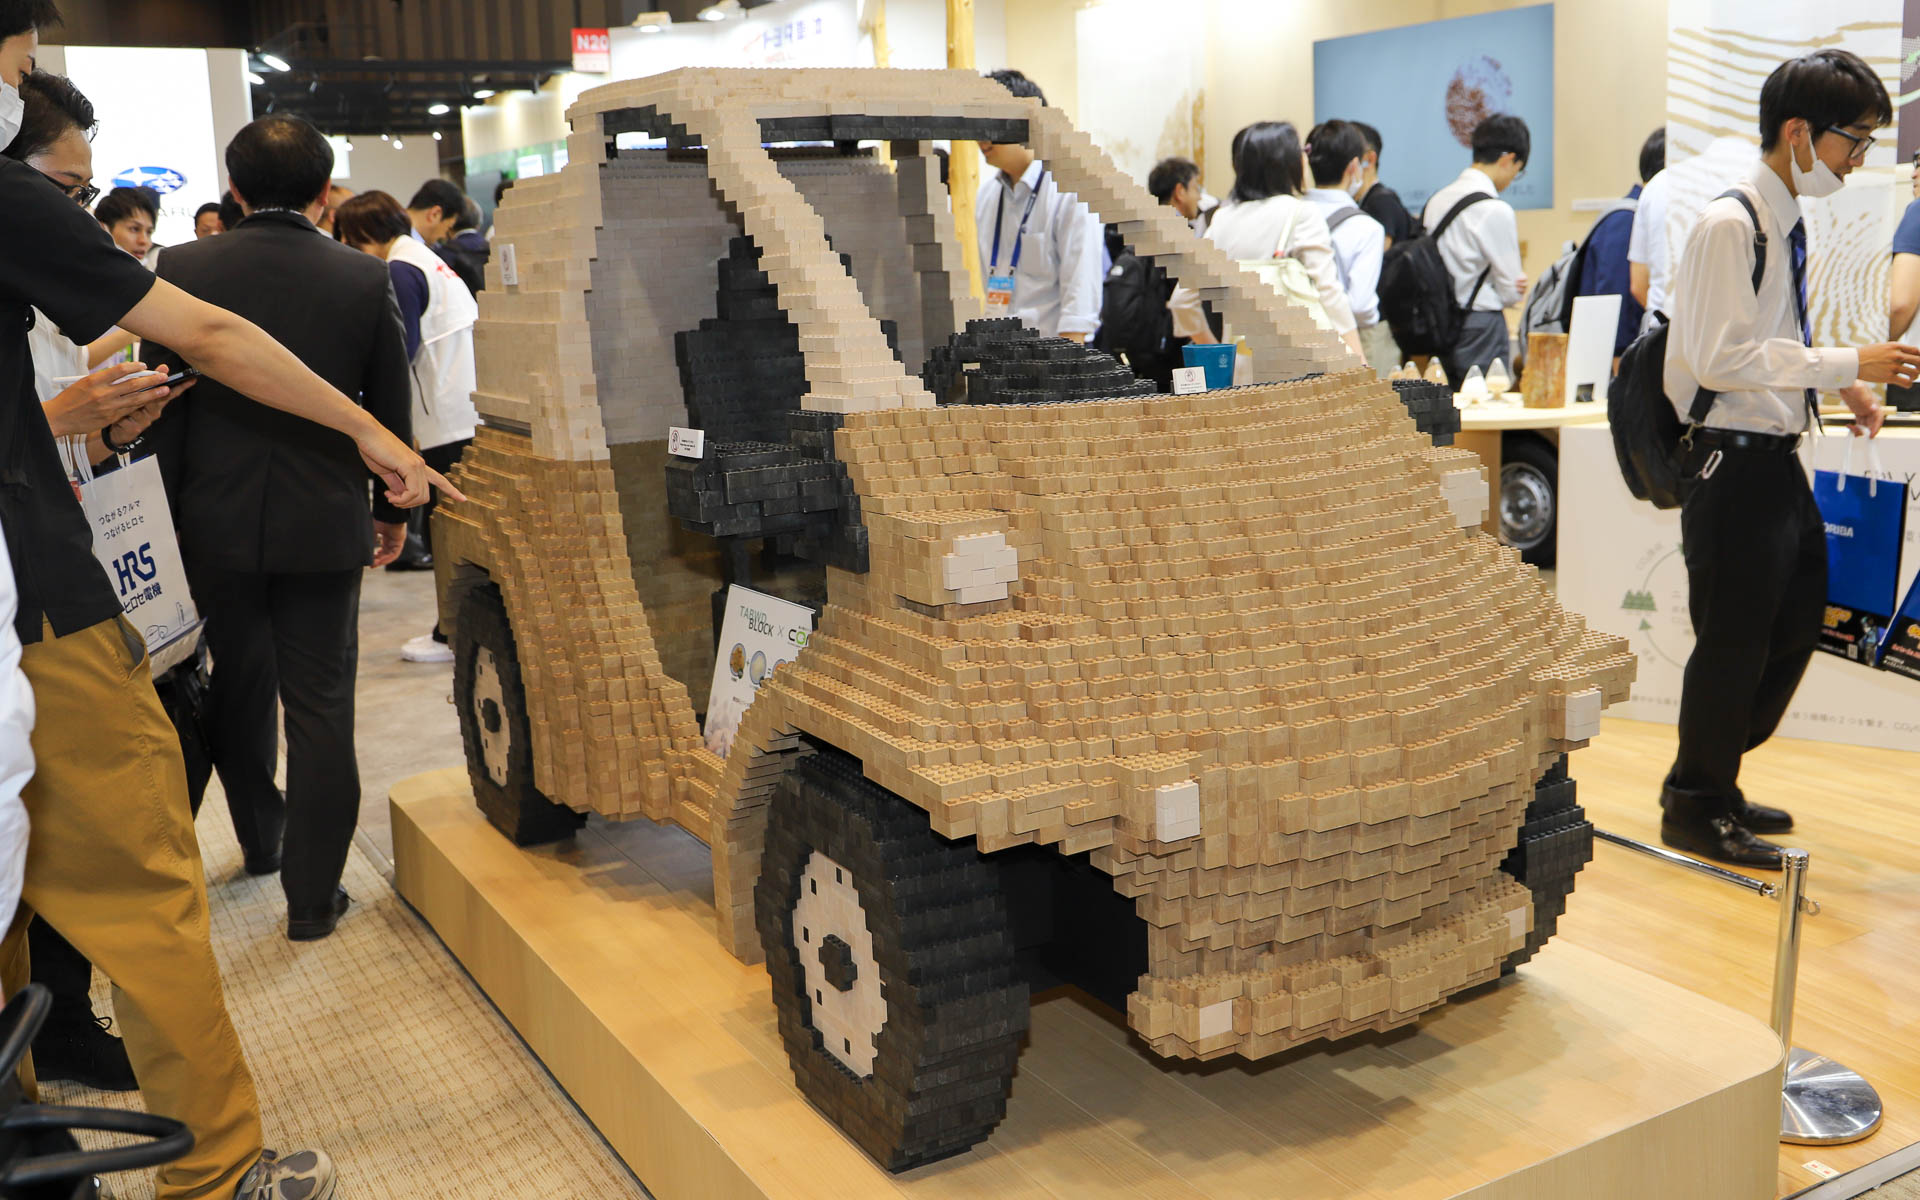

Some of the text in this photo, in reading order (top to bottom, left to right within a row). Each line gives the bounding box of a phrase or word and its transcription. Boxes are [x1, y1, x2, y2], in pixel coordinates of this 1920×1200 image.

[98, 500, 140, 525] つながるクルマ
[104, 516, 144, 540] つなげるヒロセ
[112, 541, 157, 597] HRS
[123, 582, 162, 614] ヒロセ電機
[740, 605, 767, 624] TABWD
[748, 617, 775, 637] BLOCK
